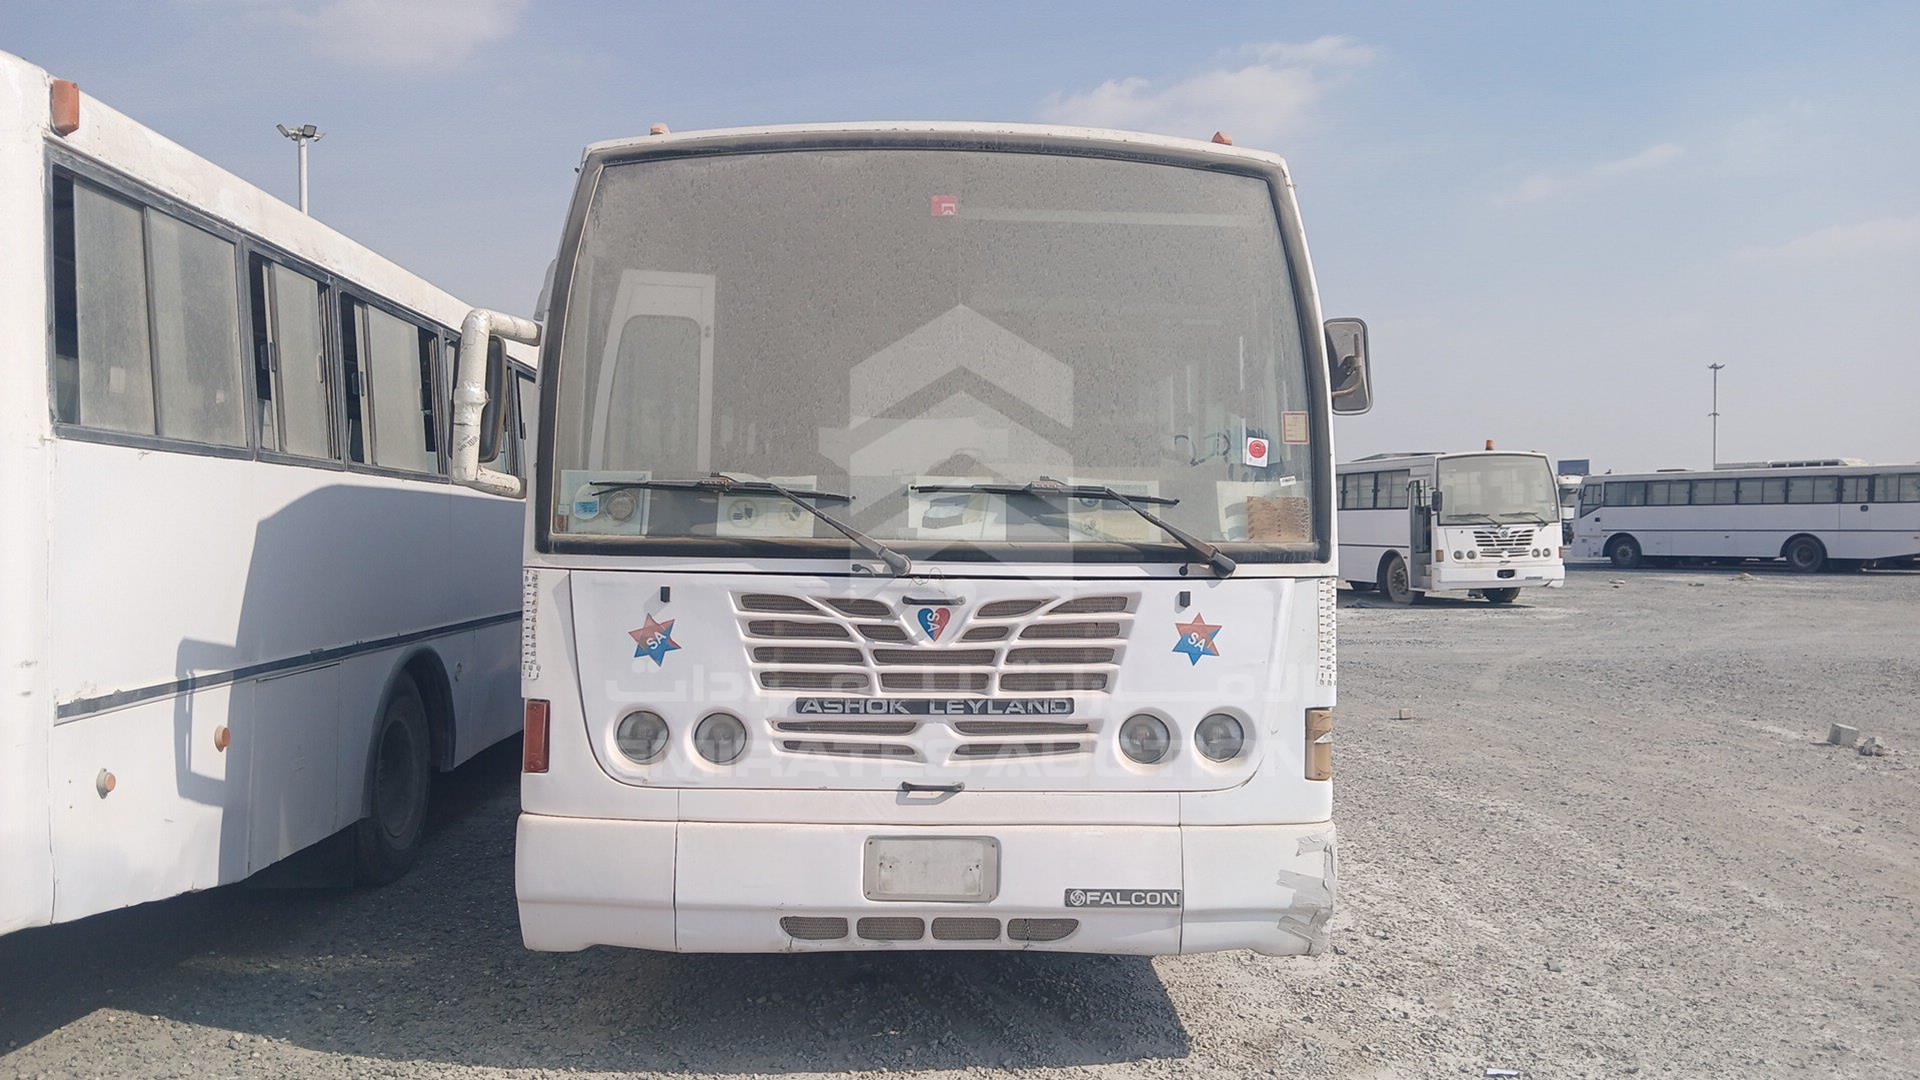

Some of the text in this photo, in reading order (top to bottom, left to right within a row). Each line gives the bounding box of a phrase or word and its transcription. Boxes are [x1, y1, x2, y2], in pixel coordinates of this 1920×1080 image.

[926, 612, 941, 633] SA
[645, 631, 667, 650] SA
[1187, 631, 1207, 652] SA
[800, 699, 1072, 715] ASHOK LEYLAND
[1085, 891, 1179, 906] FALCON
